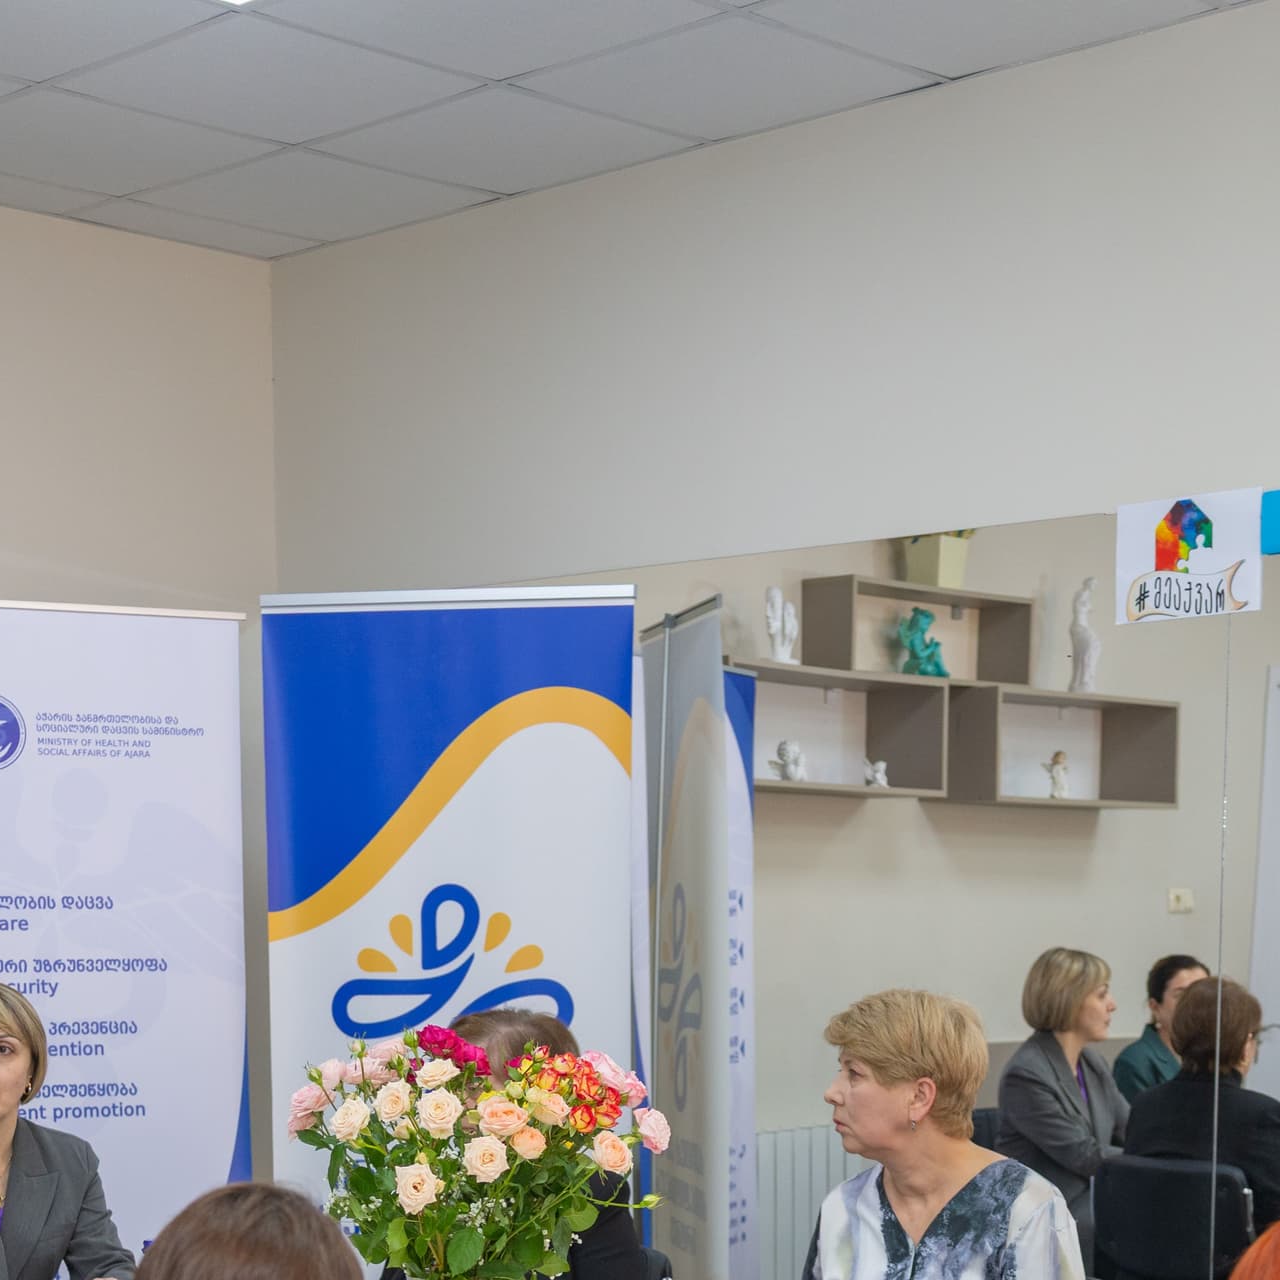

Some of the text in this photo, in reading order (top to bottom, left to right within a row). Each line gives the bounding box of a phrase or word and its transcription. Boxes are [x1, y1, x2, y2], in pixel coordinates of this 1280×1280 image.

[37, 737, 151, 748] MINISTRY OF HEALTH AND
[37, 747, 151, 759] SOCIAL AFFAIRS OF AJARA
[61, 895, 114, 910] დაცვა
[32, 958, 168, 973] უზრუნველყოფა
[7, 978, 59, 998] urity
[48, 1020, 138, 1036] პრევენცია
[47, 1040, 105, 1057] ention
[52, 1101, 146, 1122] promotion
